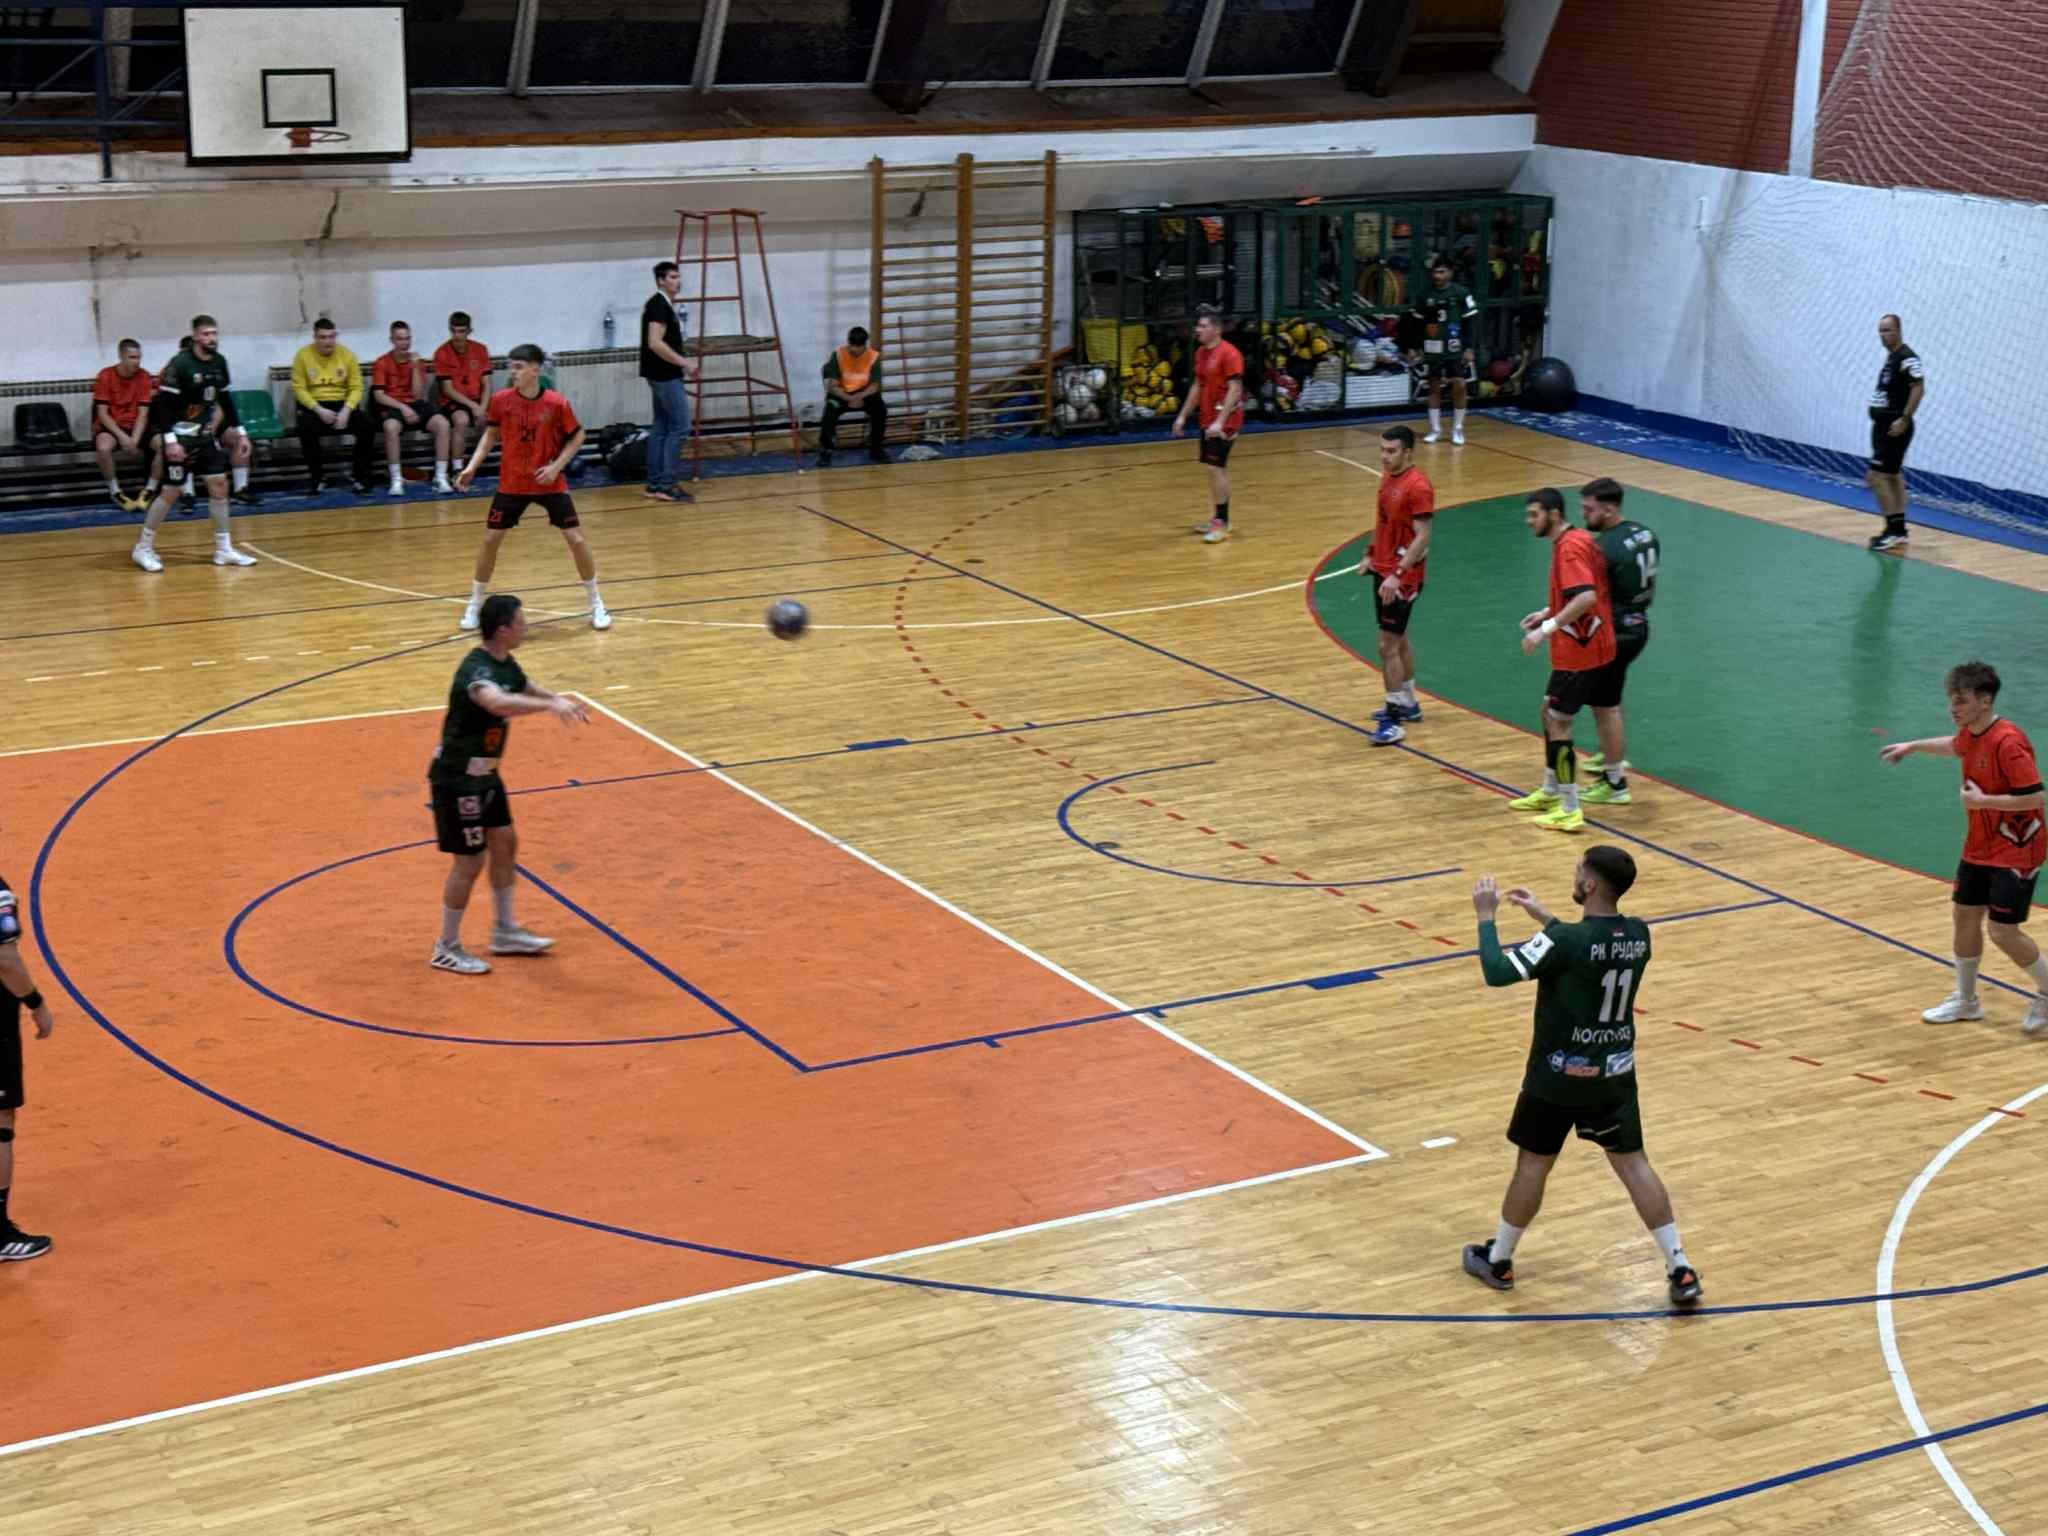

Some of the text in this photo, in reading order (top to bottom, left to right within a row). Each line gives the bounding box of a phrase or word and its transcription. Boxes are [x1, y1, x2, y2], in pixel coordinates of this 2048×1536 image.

[1437, 309, 1447, 322] 3
[1611, 940, 1647, 960] РУДАР
[1598, 969, 1633, 1022] 11
